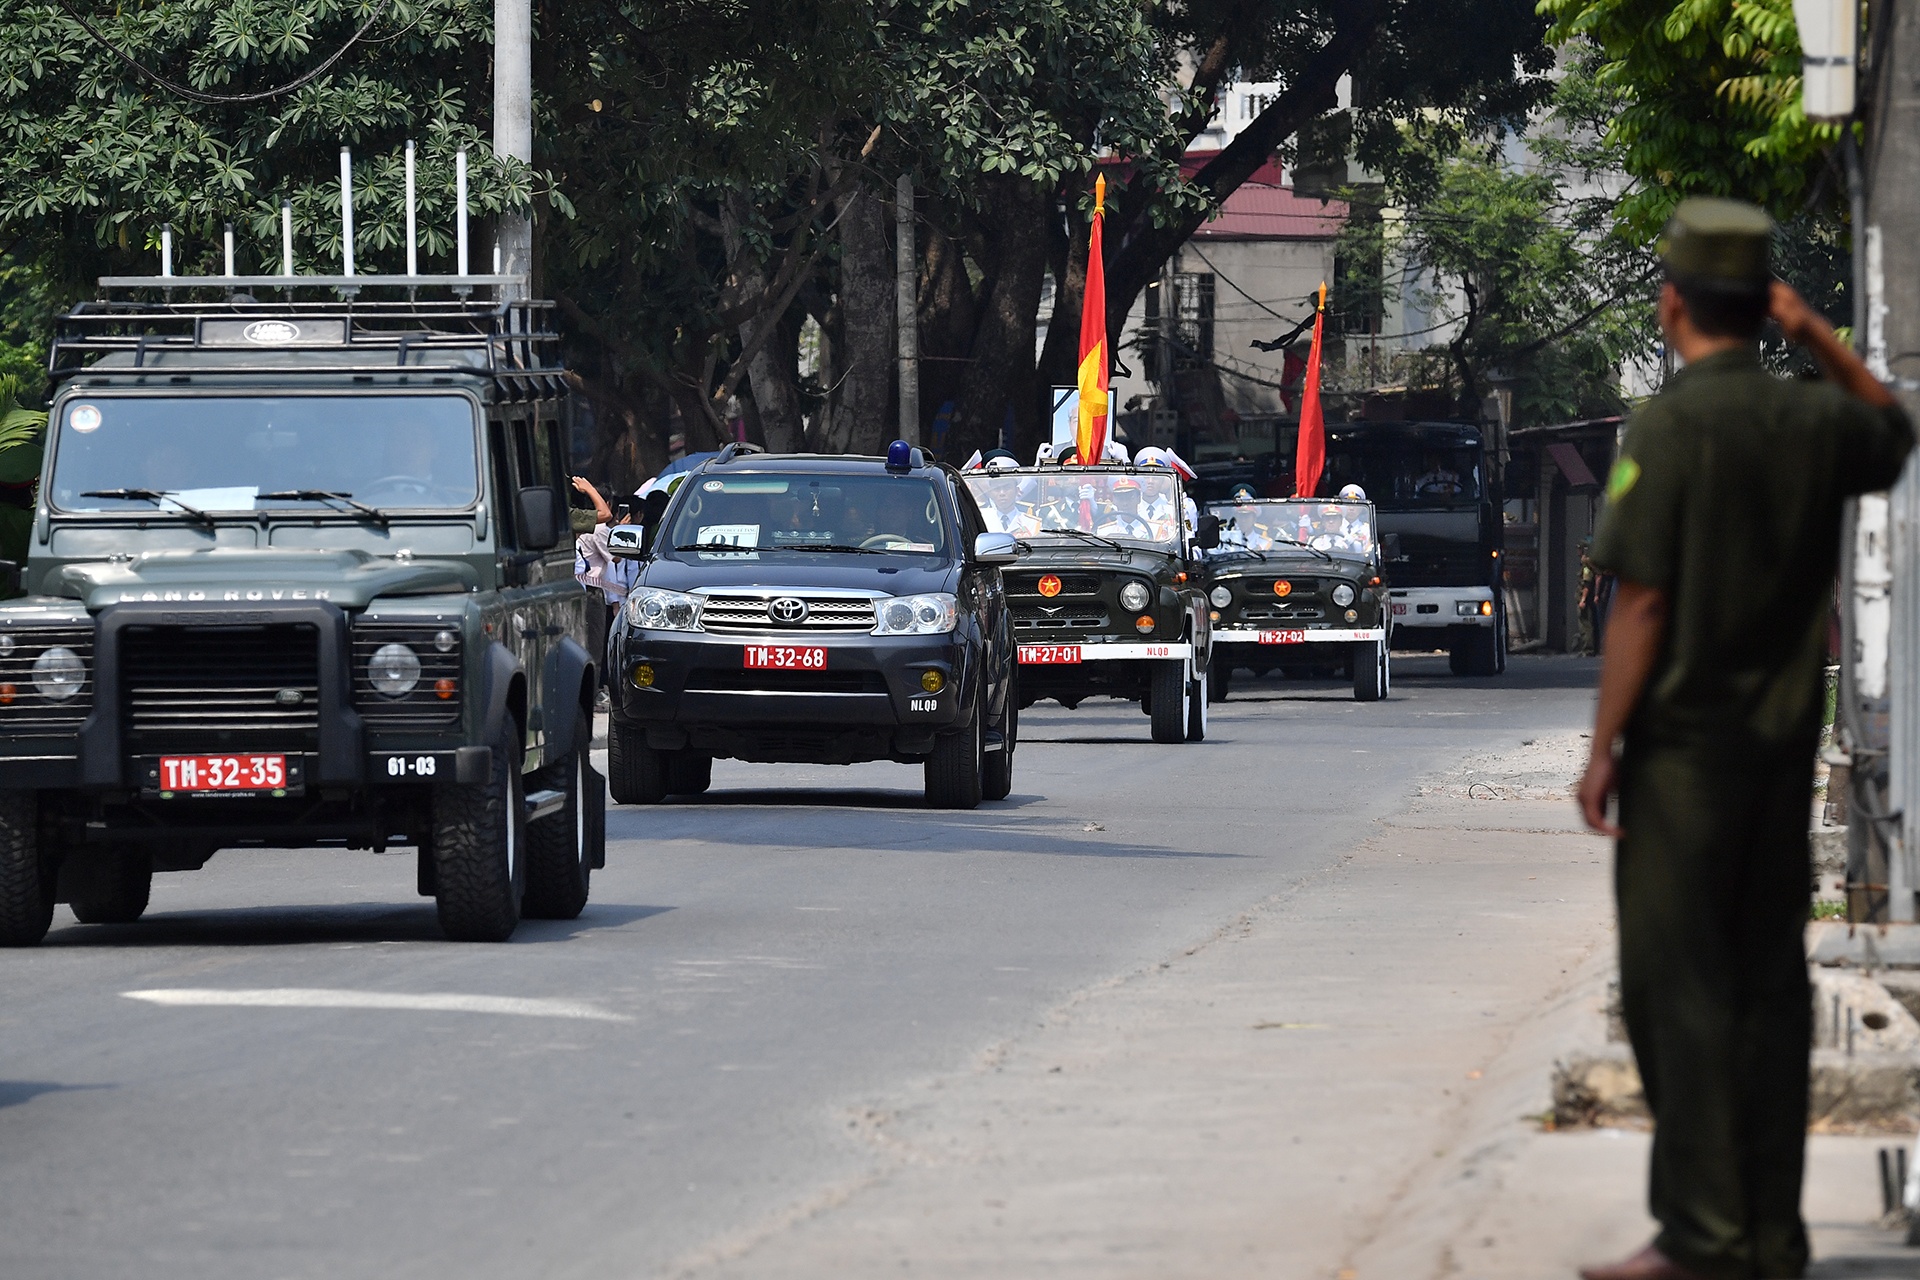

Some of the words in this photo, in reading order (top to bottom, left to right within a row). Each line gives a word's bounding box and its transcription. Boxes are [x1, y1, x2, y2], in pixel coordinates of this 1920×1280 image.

[119, 590, 206, 602] LAND
[223, 589, 331, 601] ROVER
[1259, 630, 1304, 643] TM-27-02
[747, 647, 824, 668] TM-32-68
[1019, 647, 1078, 662] TM-27-01
[164, 757, 283, 788] TM-32-35
